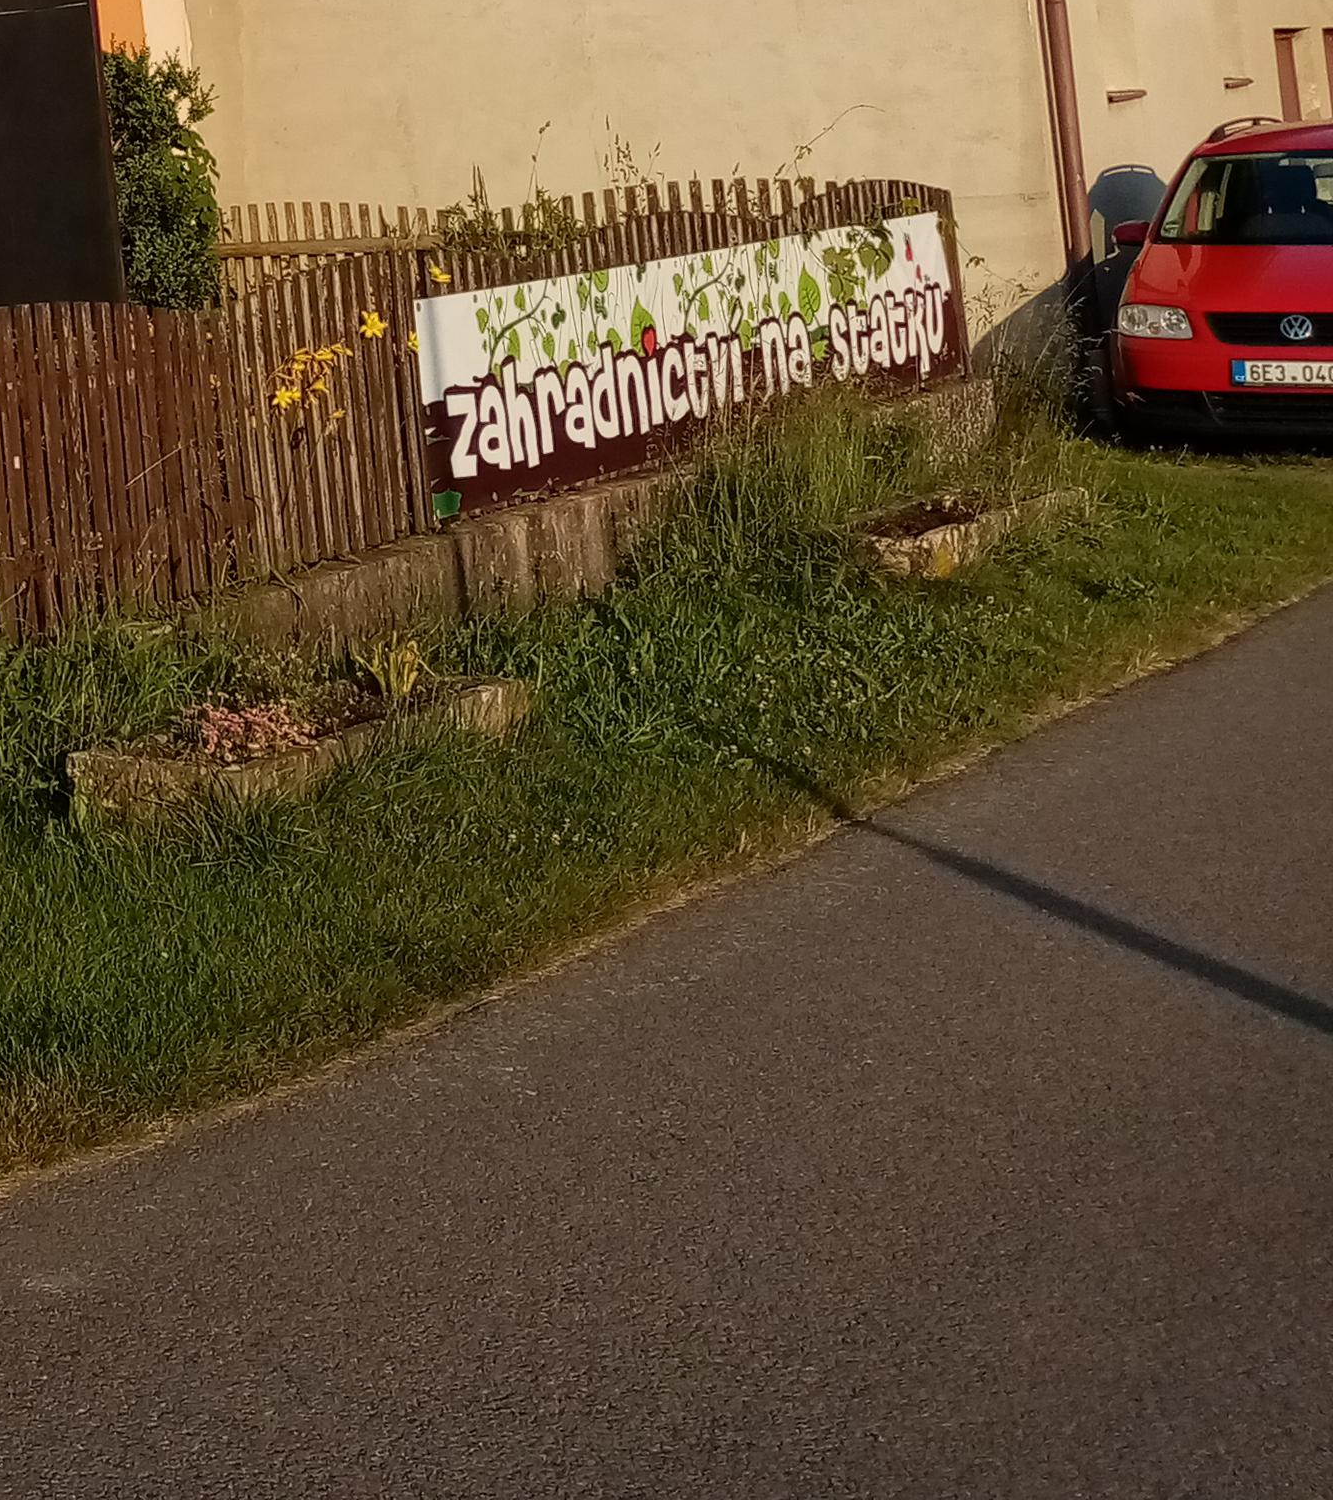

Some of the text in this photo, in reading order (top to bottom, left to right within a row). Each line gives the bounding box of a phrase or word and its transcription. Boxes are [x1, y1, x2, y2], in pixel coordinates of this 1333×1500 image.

[445, 286, 944, 478] zahradnictví na statku
[1250, 364, 1286, 381] 6E3
